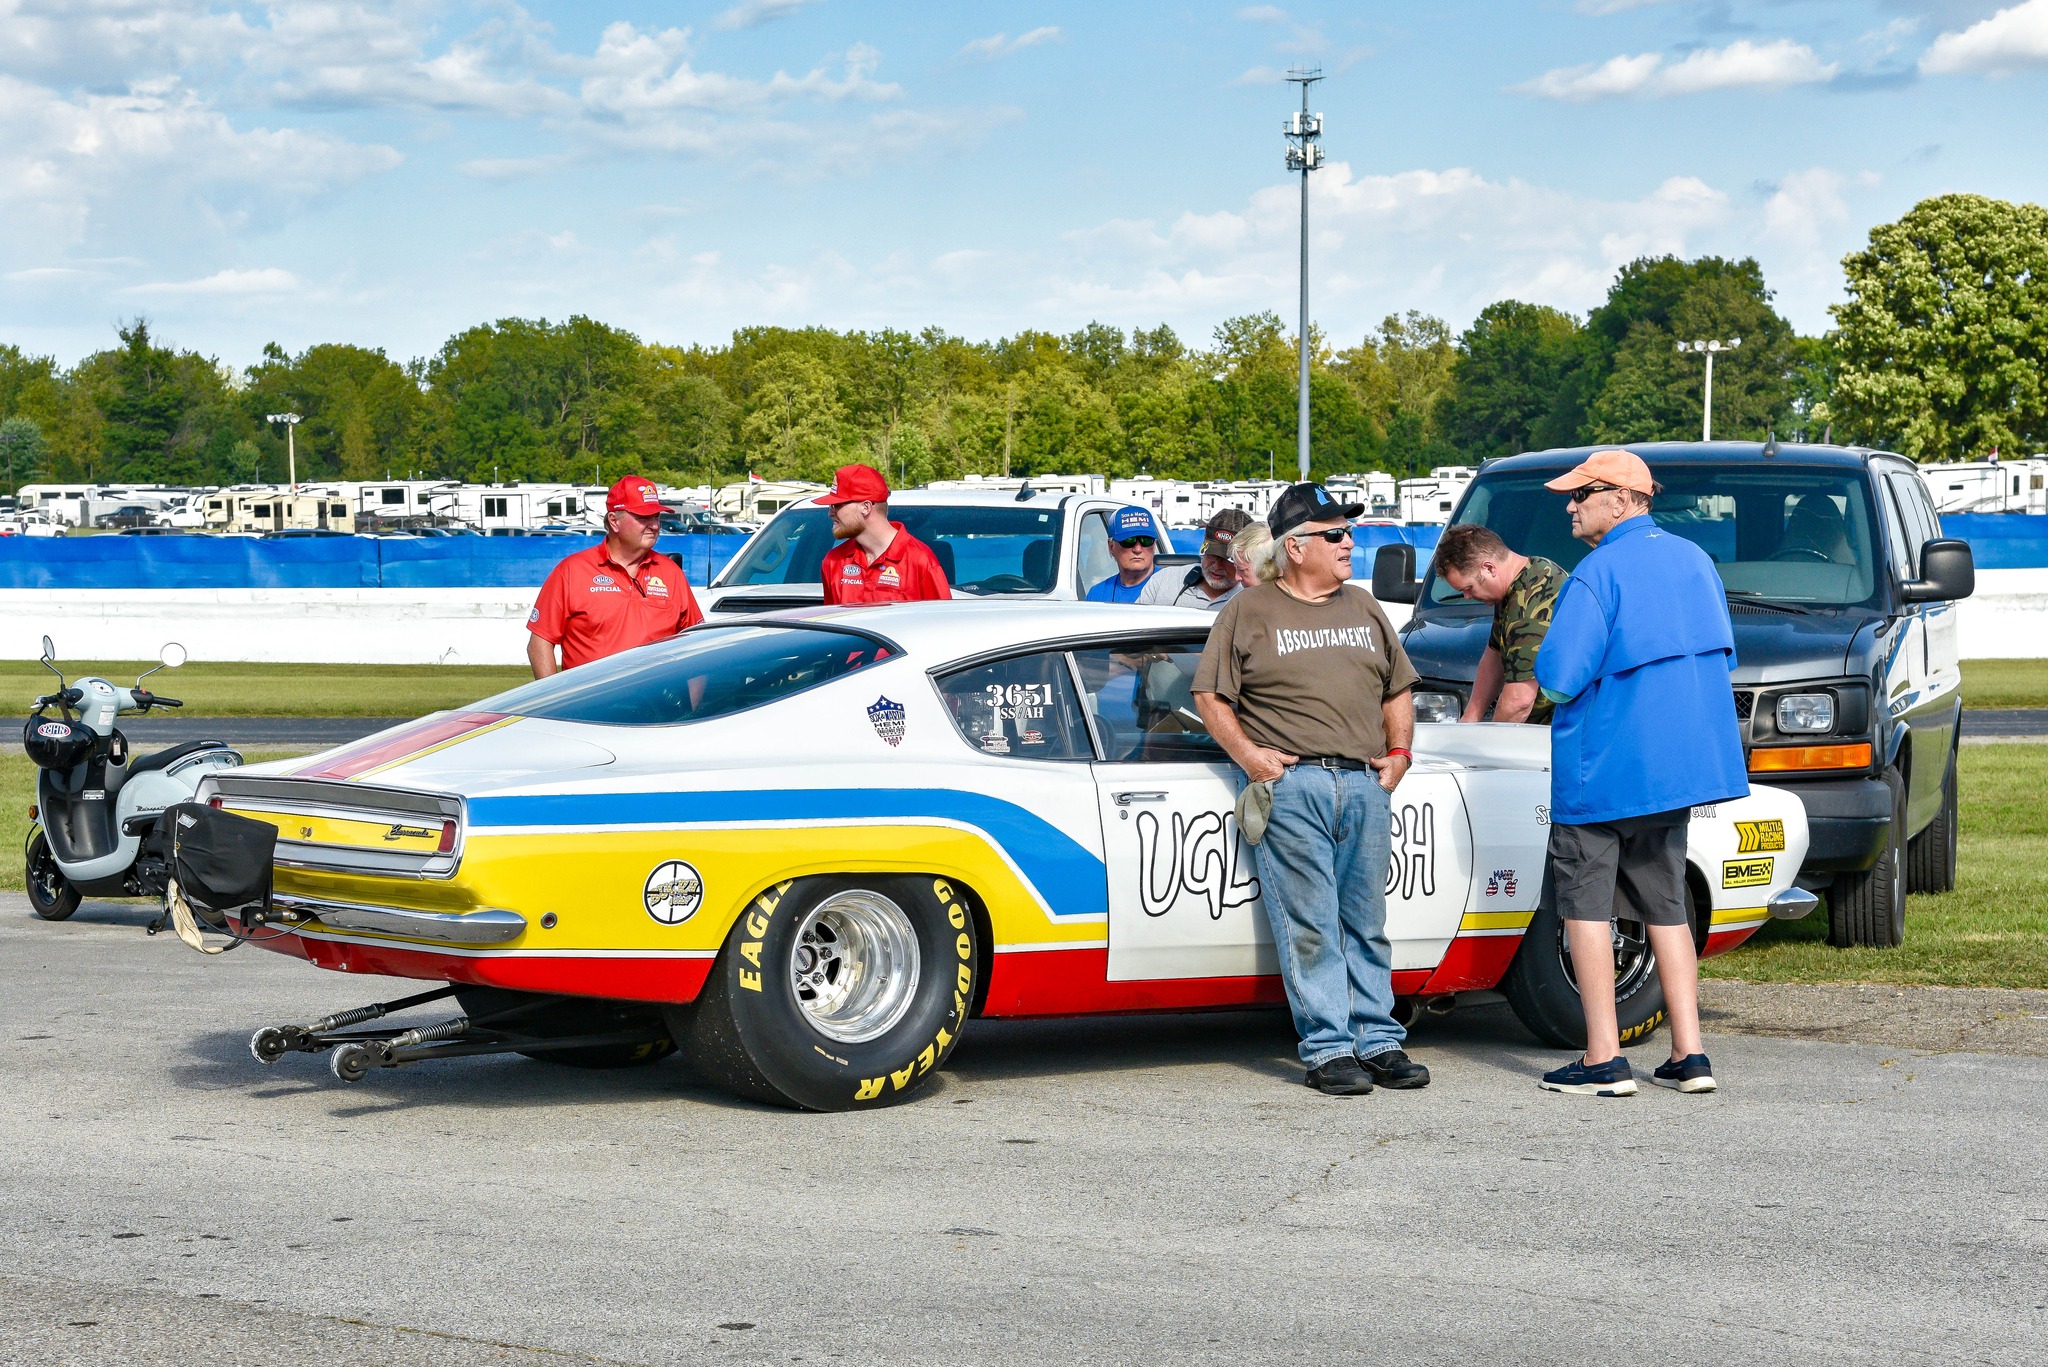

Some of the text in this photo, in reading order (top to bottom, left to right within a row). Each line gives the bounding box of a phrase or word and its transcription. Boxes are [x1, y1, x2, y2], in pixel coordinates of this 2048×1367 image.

[1217, 532, 1232, 541] NHRA
[1276, 626, 1376, 657] ABSOLUTAMENTE
[986, 683, 1054, 707] 3651
[390, 824, 431, 837] Barracuda
[1758, 821, 1782, 832] MILITIA
[1760, 831, 1784, 842] RACING
[1760, 842, 1784, 850] PRODUCTS
[1136, 810, 1261, 920] UGL
[1725, 863, 1762, 879] BME
[739, 879, 794, 993] EAGLE
